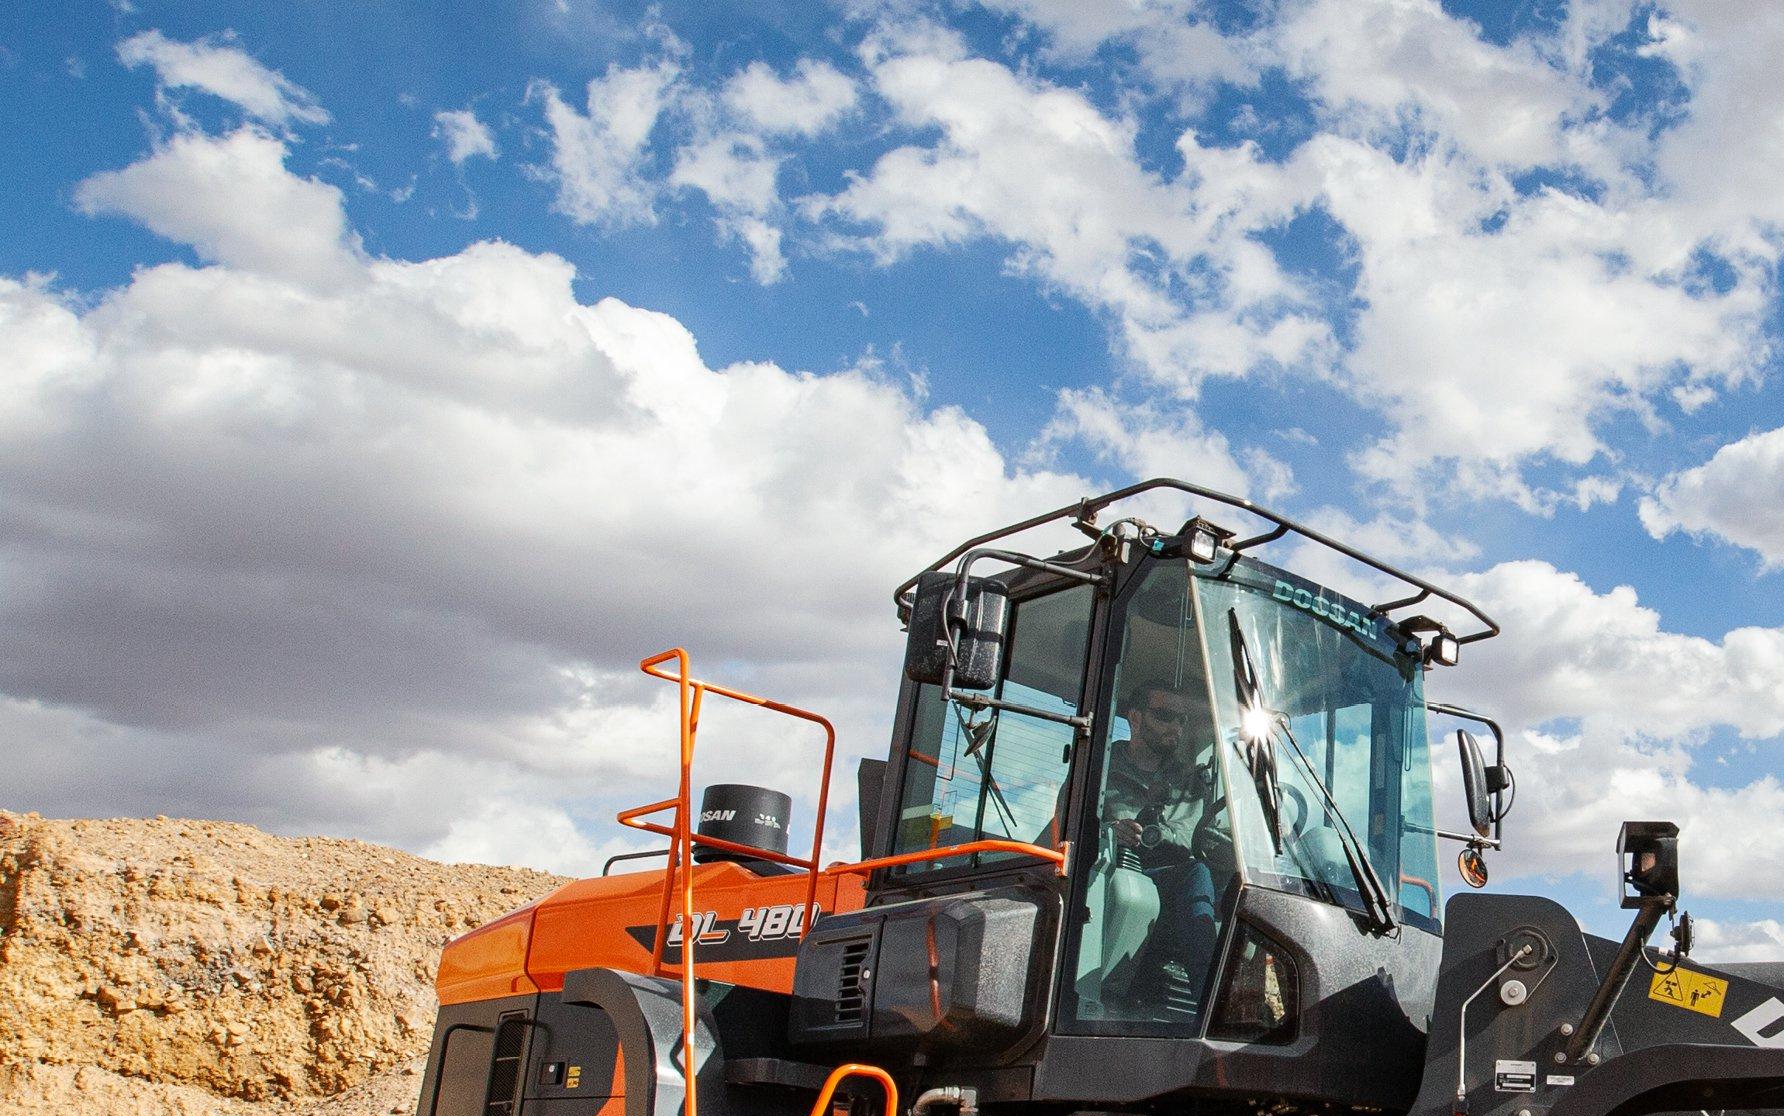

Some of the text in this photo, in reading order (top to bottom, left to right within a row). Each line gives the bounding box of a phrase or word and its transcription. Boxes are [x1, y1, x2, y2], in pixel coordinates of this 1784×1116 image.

[1272, 579, 1378, 640] DOOSAN
[667, 902, 822, 947] DL 480
